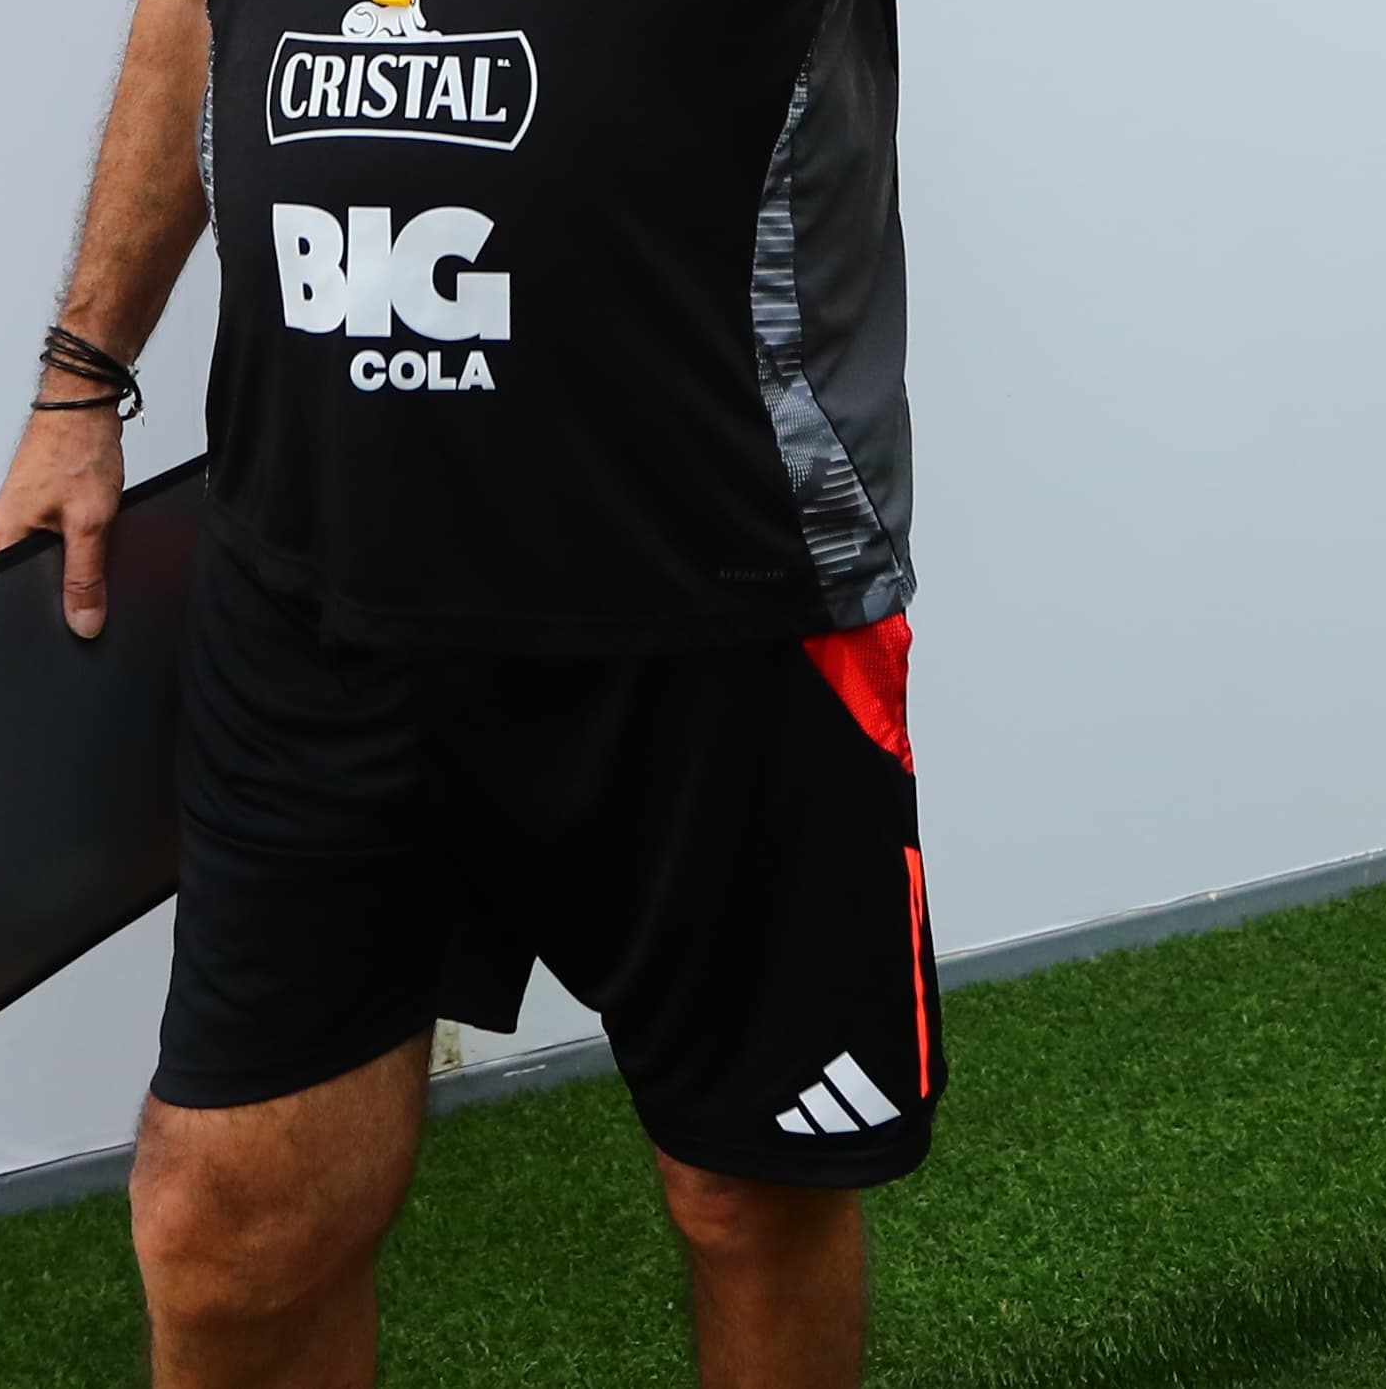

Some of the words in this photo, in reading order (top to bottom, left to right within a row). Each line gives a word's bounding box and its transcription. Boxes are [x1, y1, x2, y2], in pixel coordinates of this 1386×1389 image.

[280, 52, 507, 123] CRISTAL
[272, 203, 511, 341] BIG
[349, 349, 496, 392] COLA
